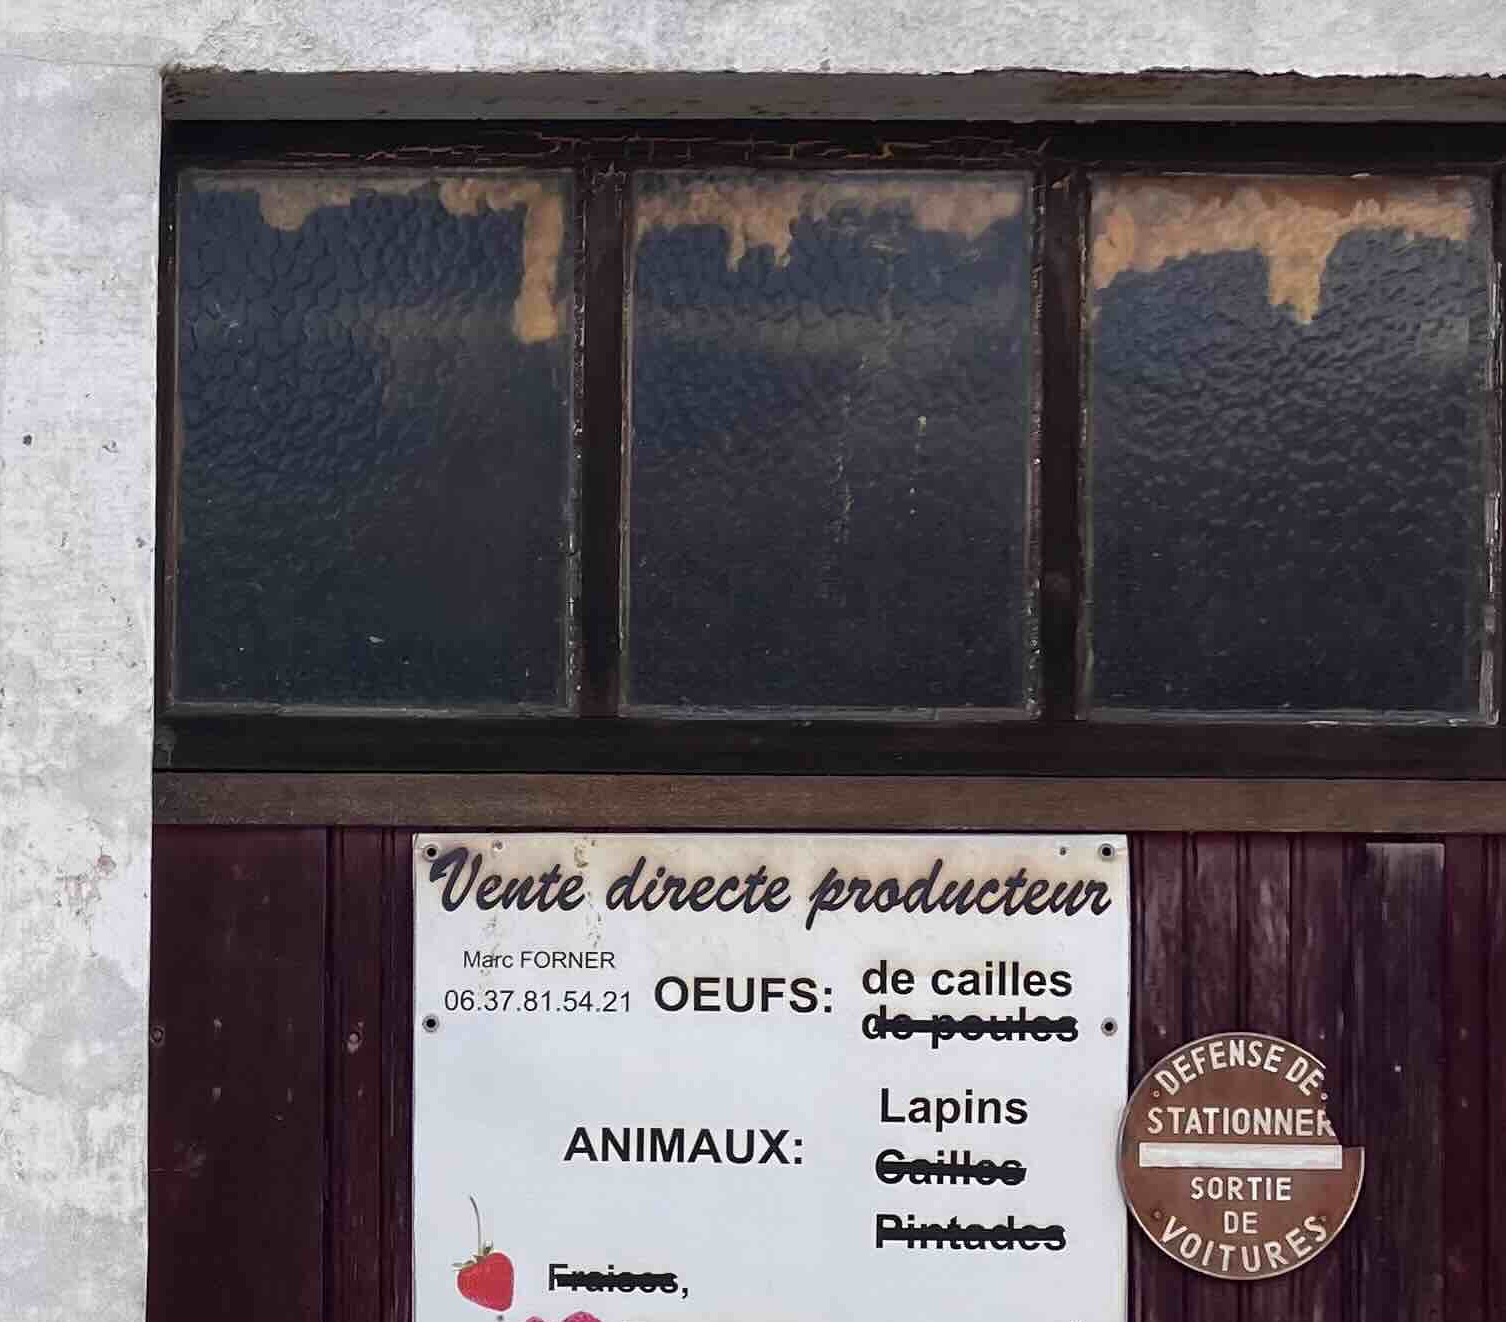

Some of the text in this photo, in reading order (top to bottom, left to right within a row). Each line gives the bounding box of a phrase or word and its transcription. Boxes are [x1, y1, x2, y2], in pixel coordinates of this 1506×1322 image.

[429, 847, 1112, 930] Vente directe producteur
[463, 950, 615, 969] Marc FORNER
[862, 960, 1072, 997] de cailles
[444, 989, 630, 1012] 06.37.81.54.21
[655, 975, 832, 1013] OEUFS:
[1154, 1039, 1326, 1097] DEFENSE DE
[881, 1088, 1028, 1132] Lapins
[564, 1126, 803, 1164] ANIMAUX:
[1190, 1176, 1292, 1201] SORTIE
[1224, 1211, 1258, 1234] DE
[1159, 1214, 1328, 1273] VOITURES
